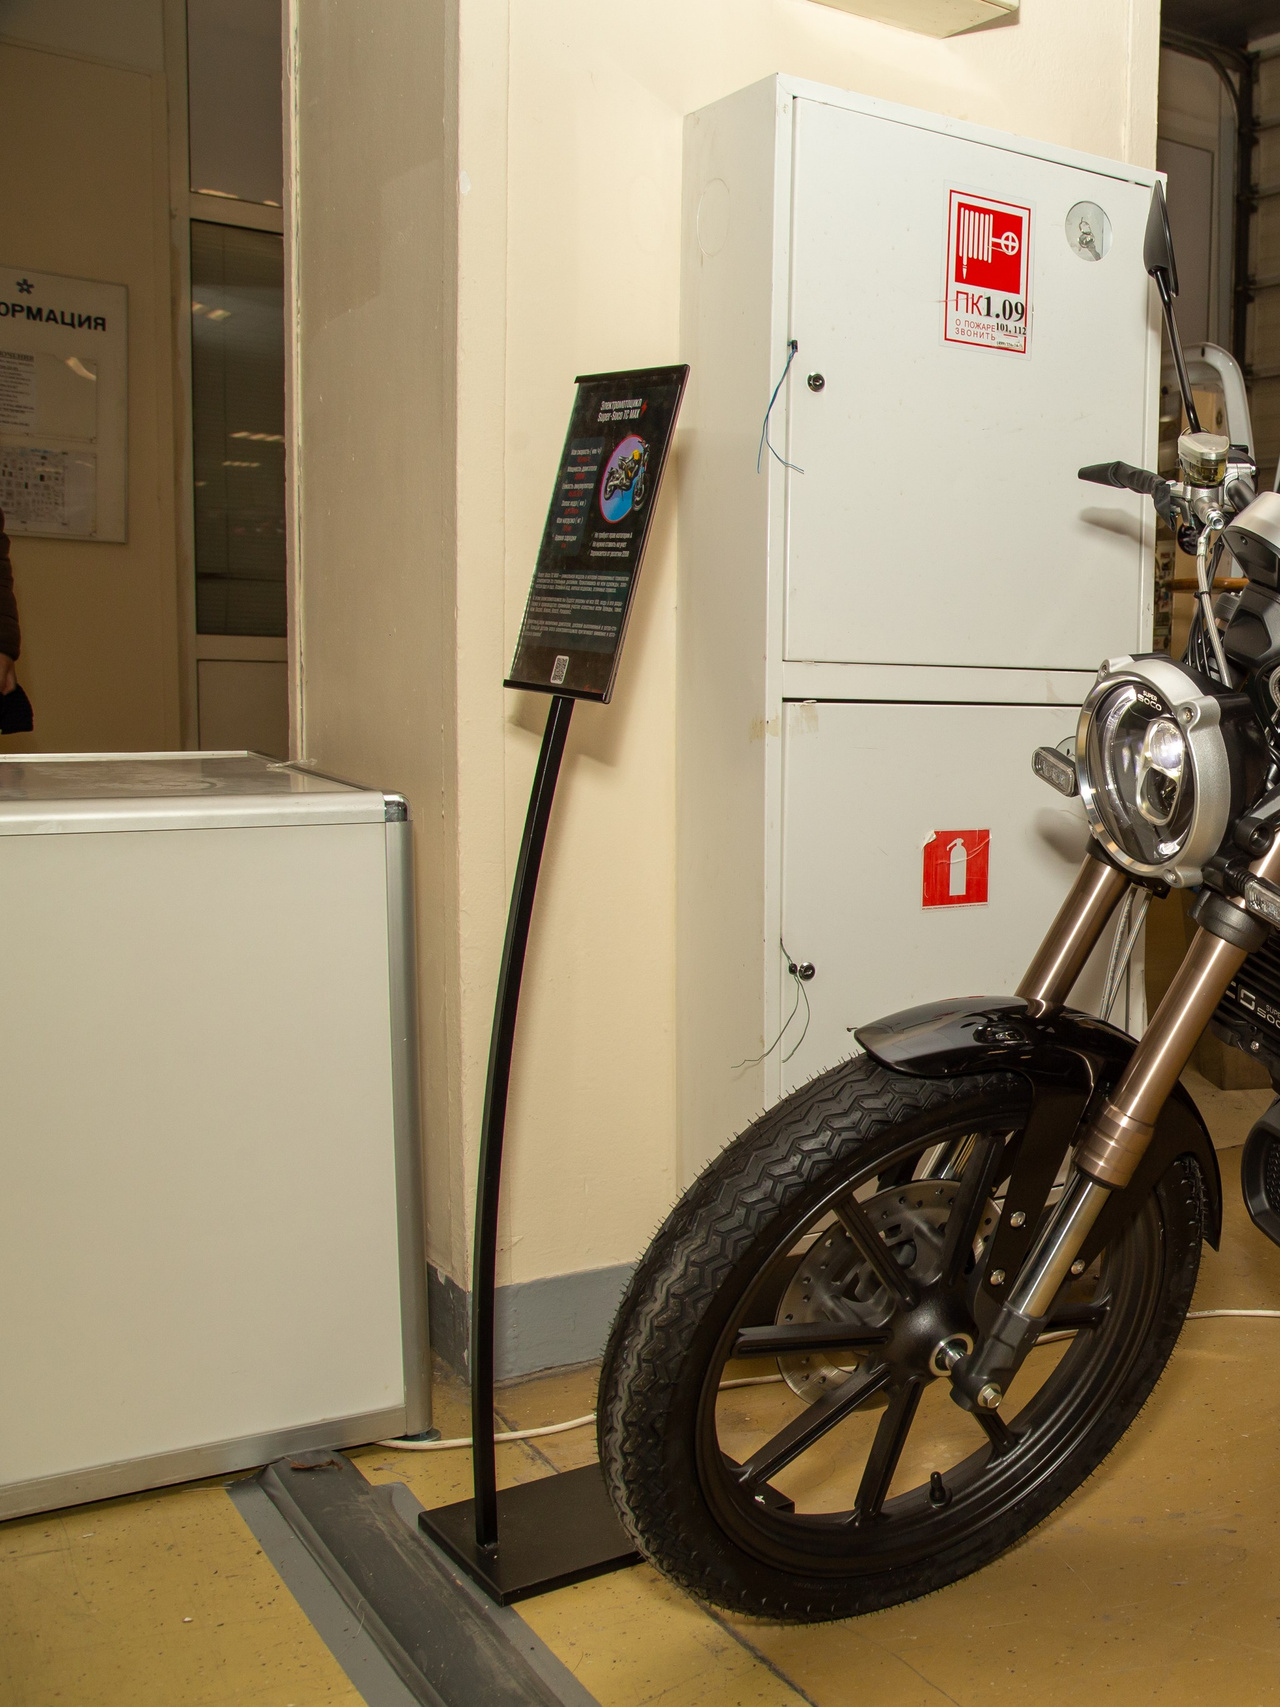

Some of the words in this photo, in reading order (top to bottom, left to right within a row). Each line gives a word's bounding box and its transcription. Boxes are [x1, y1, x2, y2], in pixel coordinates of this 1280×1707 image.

[955, 290, 983, 316] ПК
[984, 296, 1025, 322] 1.09
[0, 302, 107, 332] ОРМАЦИЯ
[955, 318, 961, 326] О
[964, 320, 996, 332] ПОЖАРЕ
[955, 328, 996, 341] ЗВОНИТЬ
[1014, 326, 1026, 335] 112
[1137, 693, 1162, 711] SOCO
